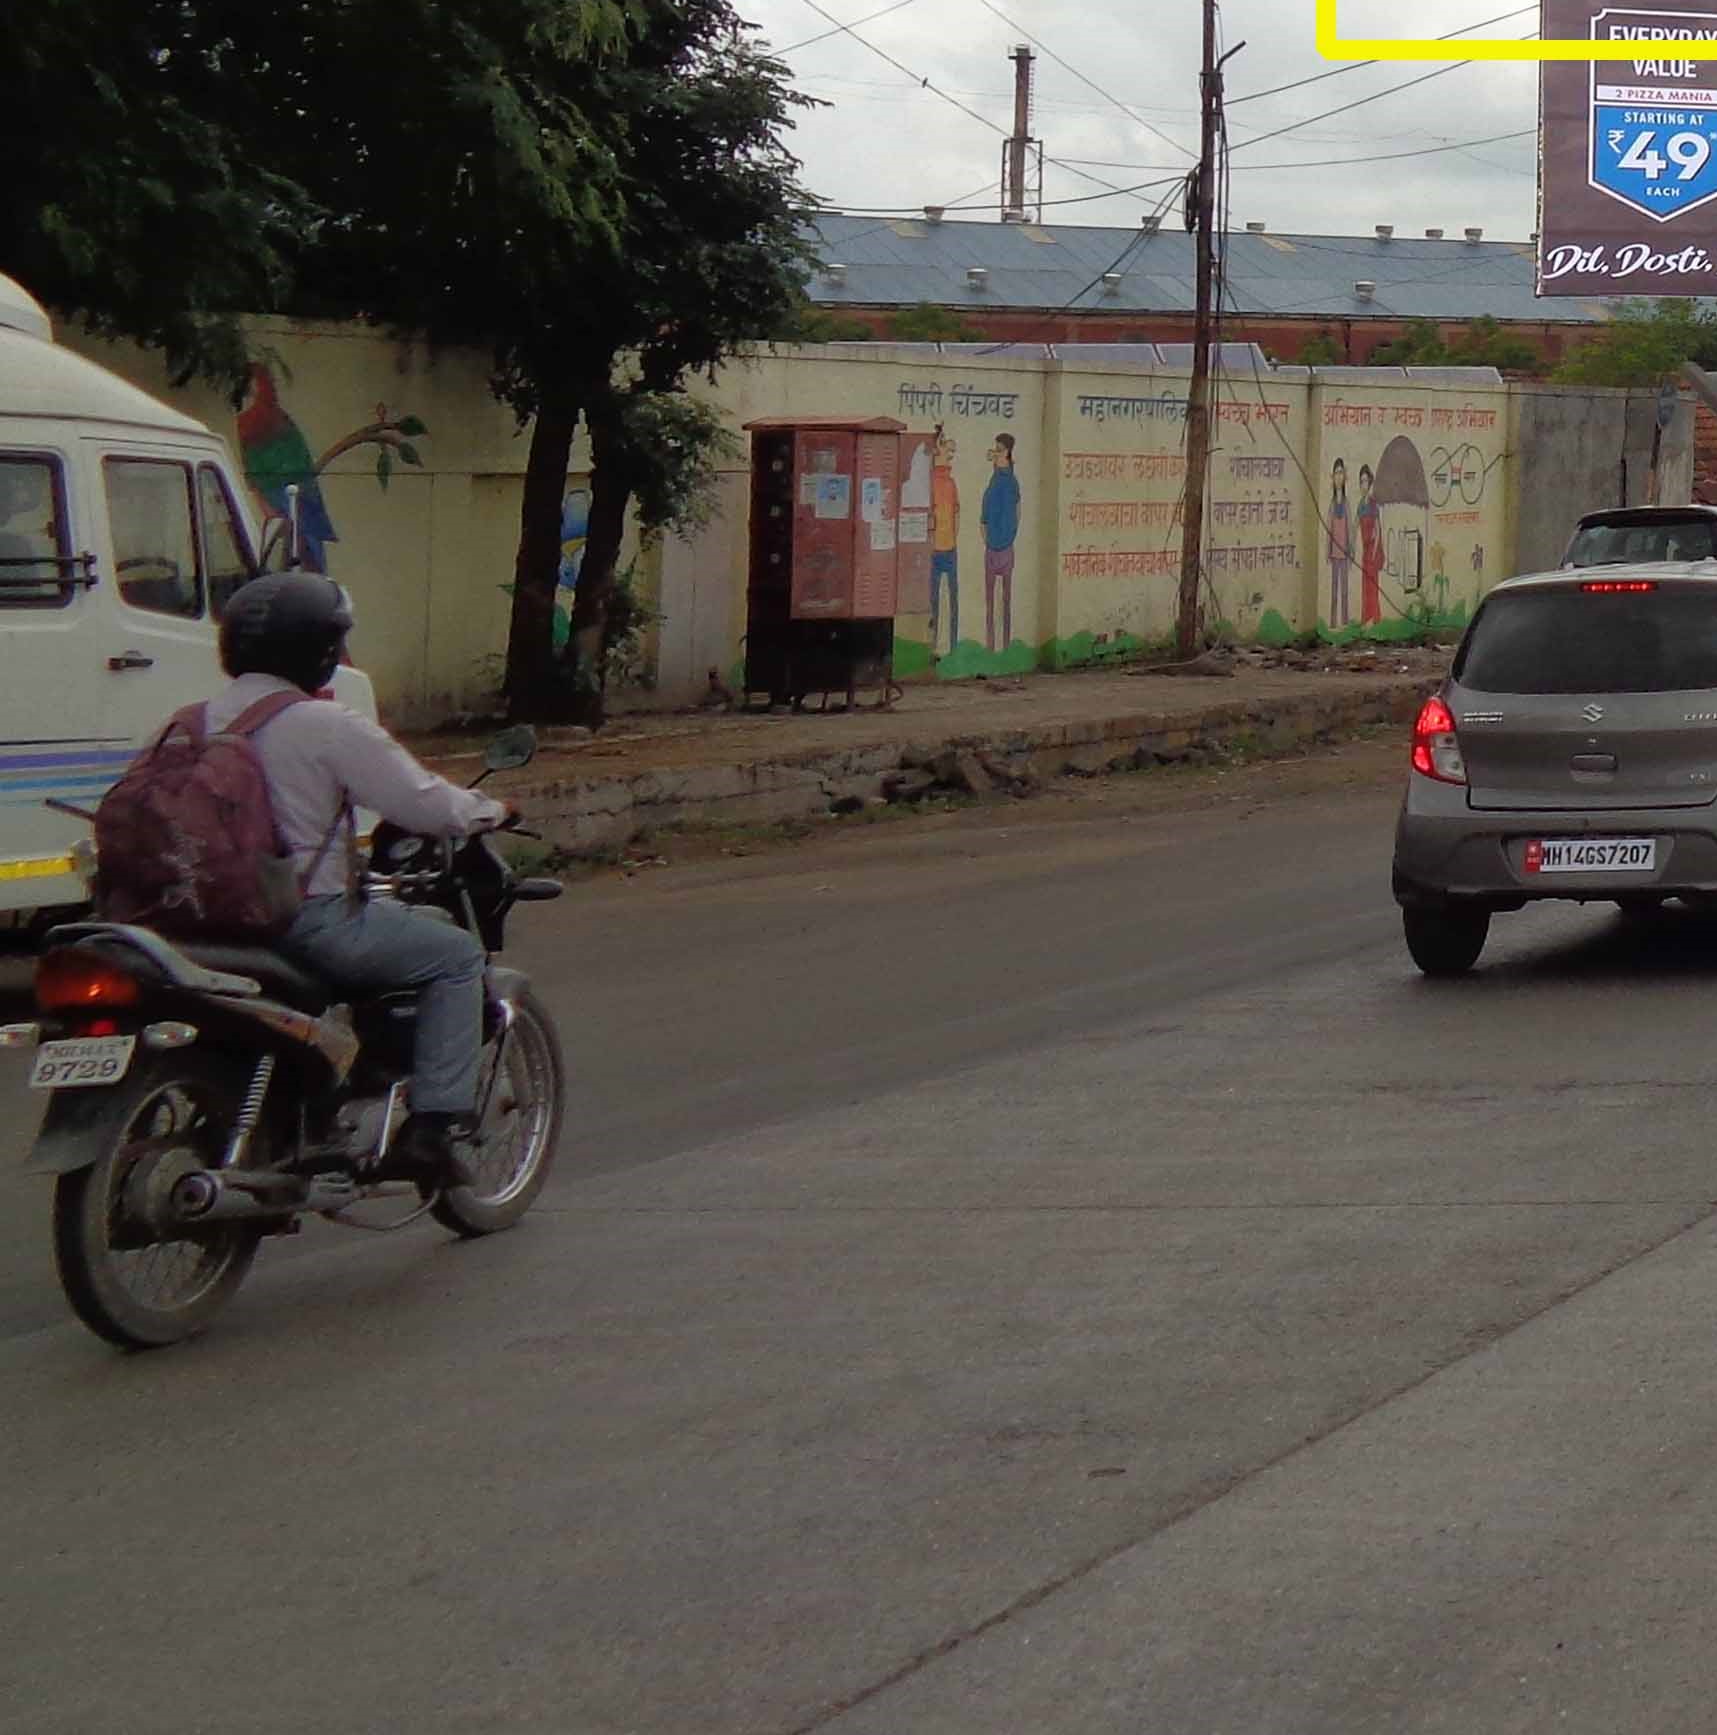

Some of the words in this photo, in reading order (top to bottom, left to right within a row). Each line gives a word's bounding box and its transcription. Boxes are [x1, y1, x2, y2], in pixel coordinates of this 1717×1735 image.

[1632, 60, 1697, 78] VALUE
[1616, 89, 1623, 98] 2
[1628, 89, 1664, 100] PIZZA
[1668, 91, 1713, 101] MANIA
[1624, 112, 1685, 124] STARTING
[1690, 114, 1704, 125] AT
[1646, 187, 1680, 198] EACH
[1543, 244, 1609, 279] Dil,
[1611, 243, 1713, 278] Dosti,
